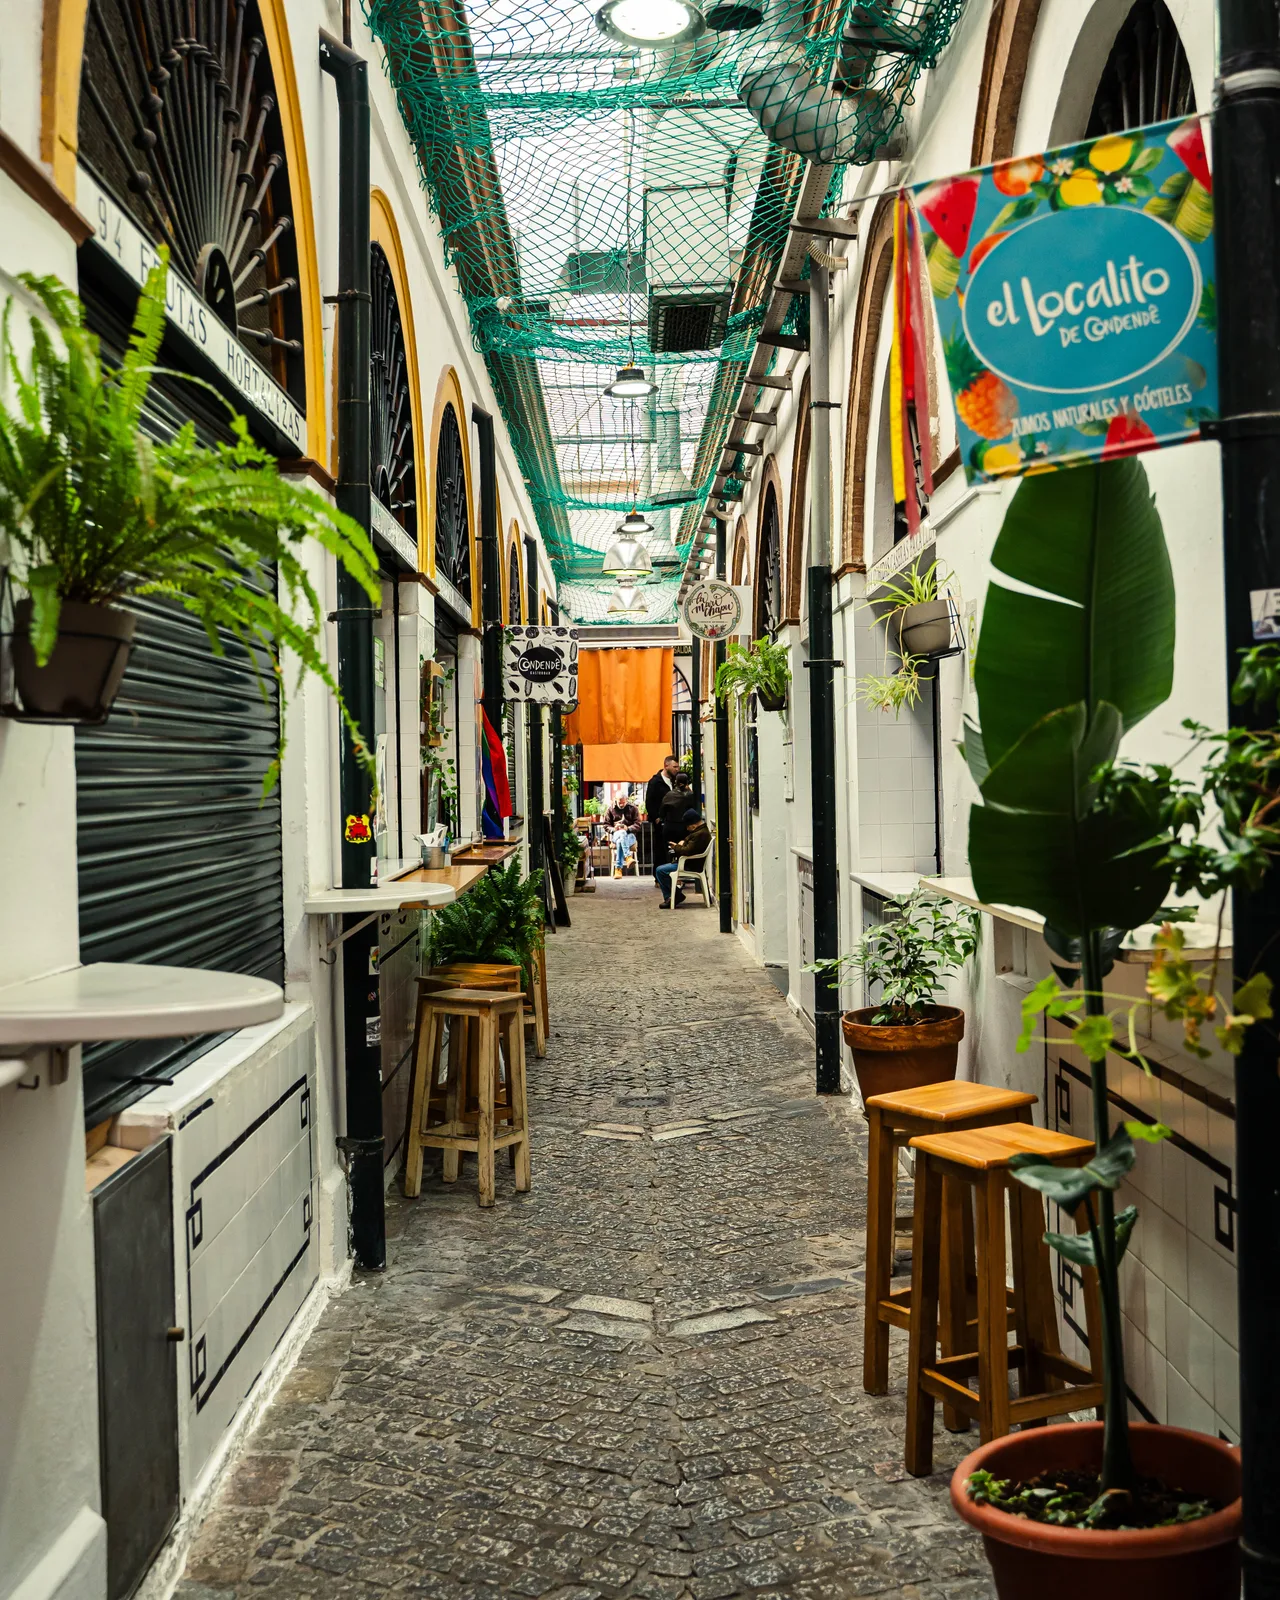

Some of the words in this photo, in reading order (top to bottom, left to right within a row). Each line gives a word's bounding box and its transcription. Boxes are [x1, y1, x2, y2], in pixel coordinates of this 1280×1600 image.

[986, 281, 1020, 327] el
[1021, 255, 1170, 336] Localito
[141, 243, 207, 345] FUTAS
[227, 339, 300, 441] HORTALIZAS
[1058, 325, 1082, 348] DE
[1011, 411, 1050, 438] ZUMOS
[1053, 398, 1118, 429] NATURALES
[1119, 395, 1129, 415] Y
[1133, 383, 1192, 412] CÓCTELES
